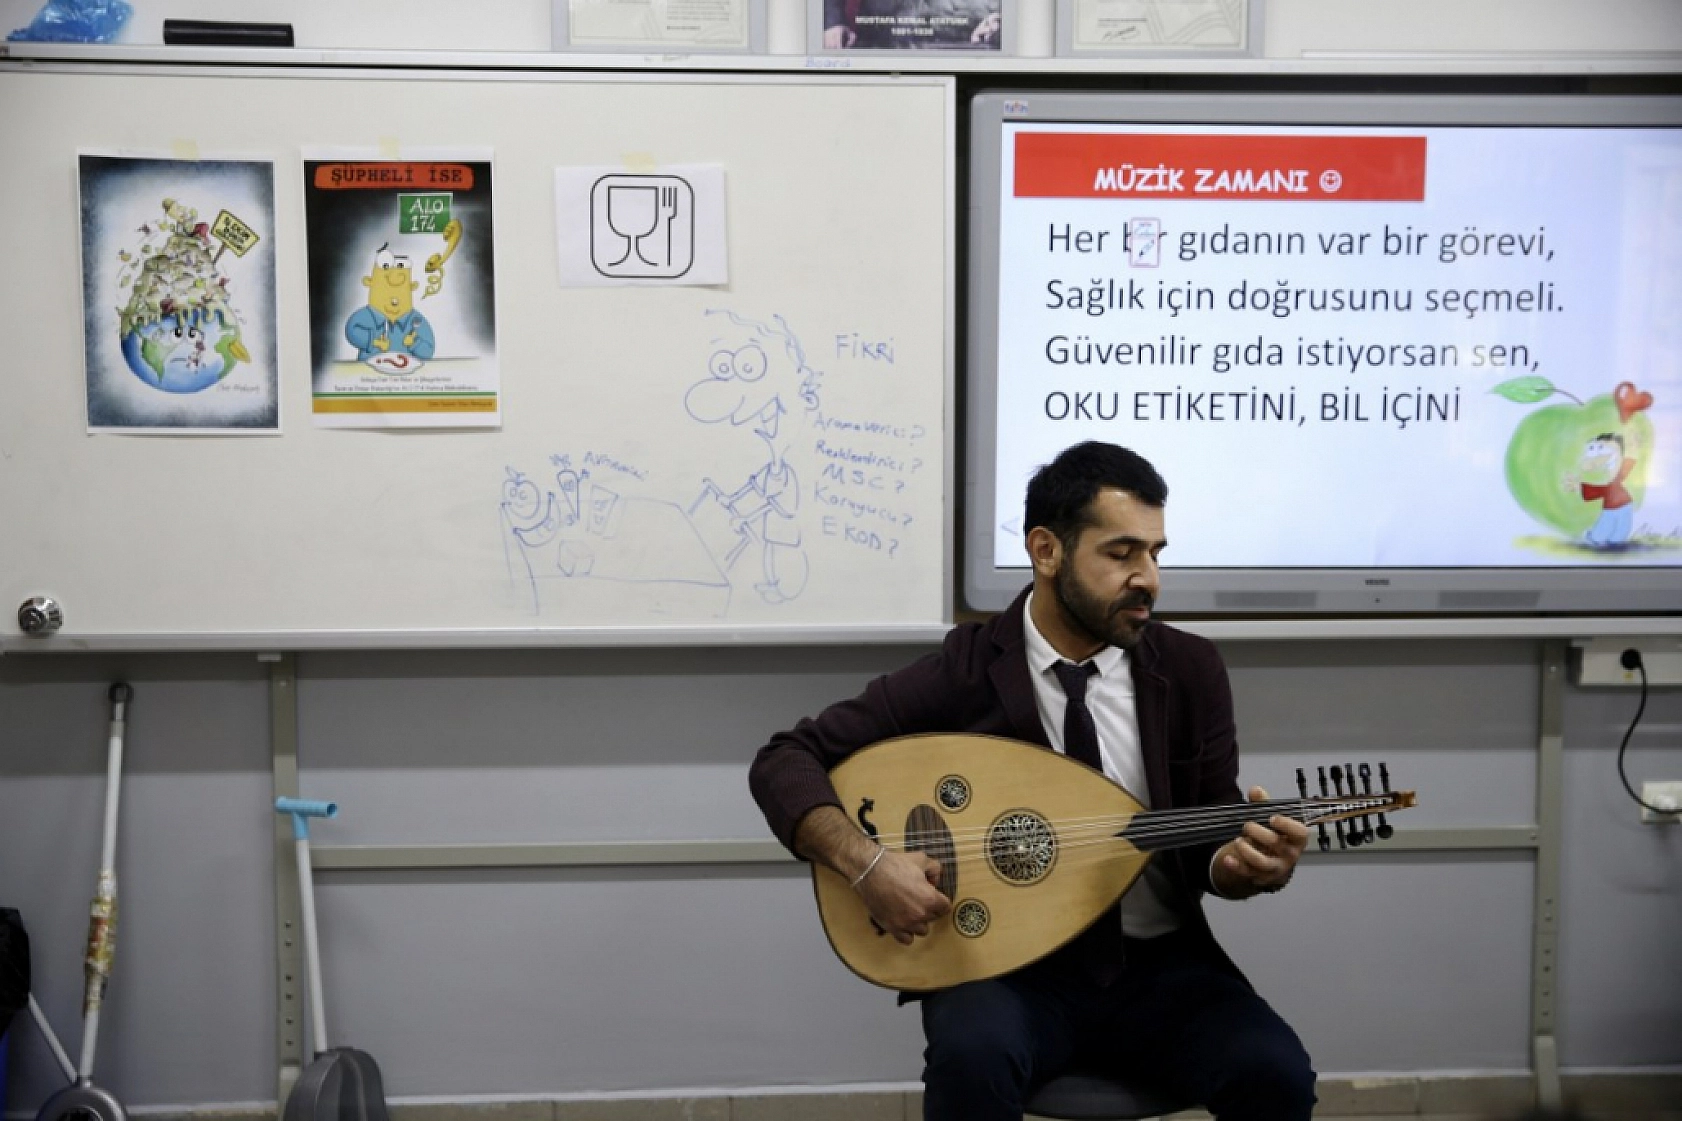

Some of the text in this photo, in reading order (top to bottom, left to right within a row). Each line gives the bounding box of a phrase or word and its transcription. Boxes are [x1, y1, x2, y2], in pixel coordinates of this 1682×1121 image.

[331, 164, 463, 186] ŞÜPHELİ İSE
[1094, 164, 1309, 194] MÜZİK ZAMANI
[409, 198, 444, 215] ALO
[410, 215, 436, 232] 174
[1048, 222, 1110, 253] Her
[1178, 223, 1305, 261] gıdanın
[1318, 232, 1372, 255] var
[1384, 223, 1430, 256] bir
[1438, 225, 1555, 263] görevi,
[1045, 278, 1565, 319] Sağlık için doğrusunu seçmeli.
[1045, 335, 1540, 374] Güvenilir gıda istiyorsan sen,
[1044, 385, 1461, 429] OKU ETİKETİNİ, BİL İÇİNİ
